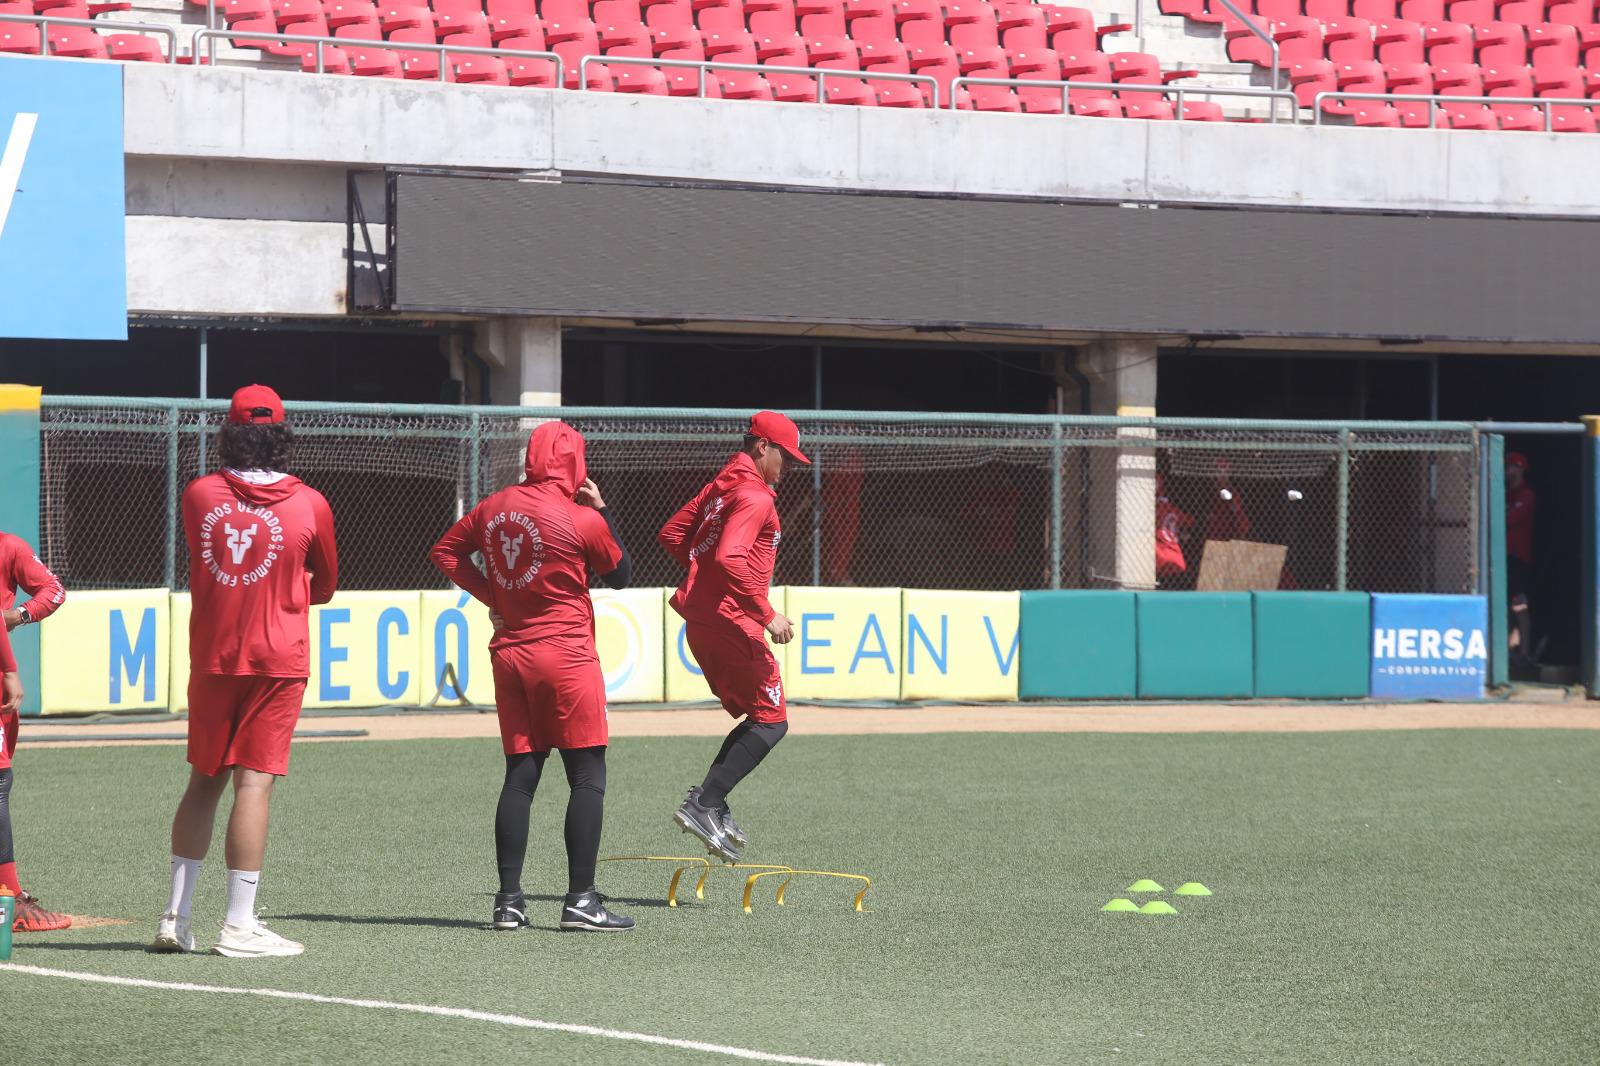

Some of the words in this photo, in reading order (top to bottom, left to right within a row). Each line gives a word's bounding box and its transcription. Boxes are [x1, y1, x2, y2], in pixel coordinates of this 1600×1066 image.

[200, 503, 233, 541] SOMOS
[484, 511, 506, 545] SOMOS
[509, 511, 544, 551] VENADOS
[242, 551, 278, 586] SOMOS
[515, 559, 542, 590] SOMOS
[1374, 627, 1488, 660] HERSA
[1387, 665, 1478, 676] CORPORATIVO
